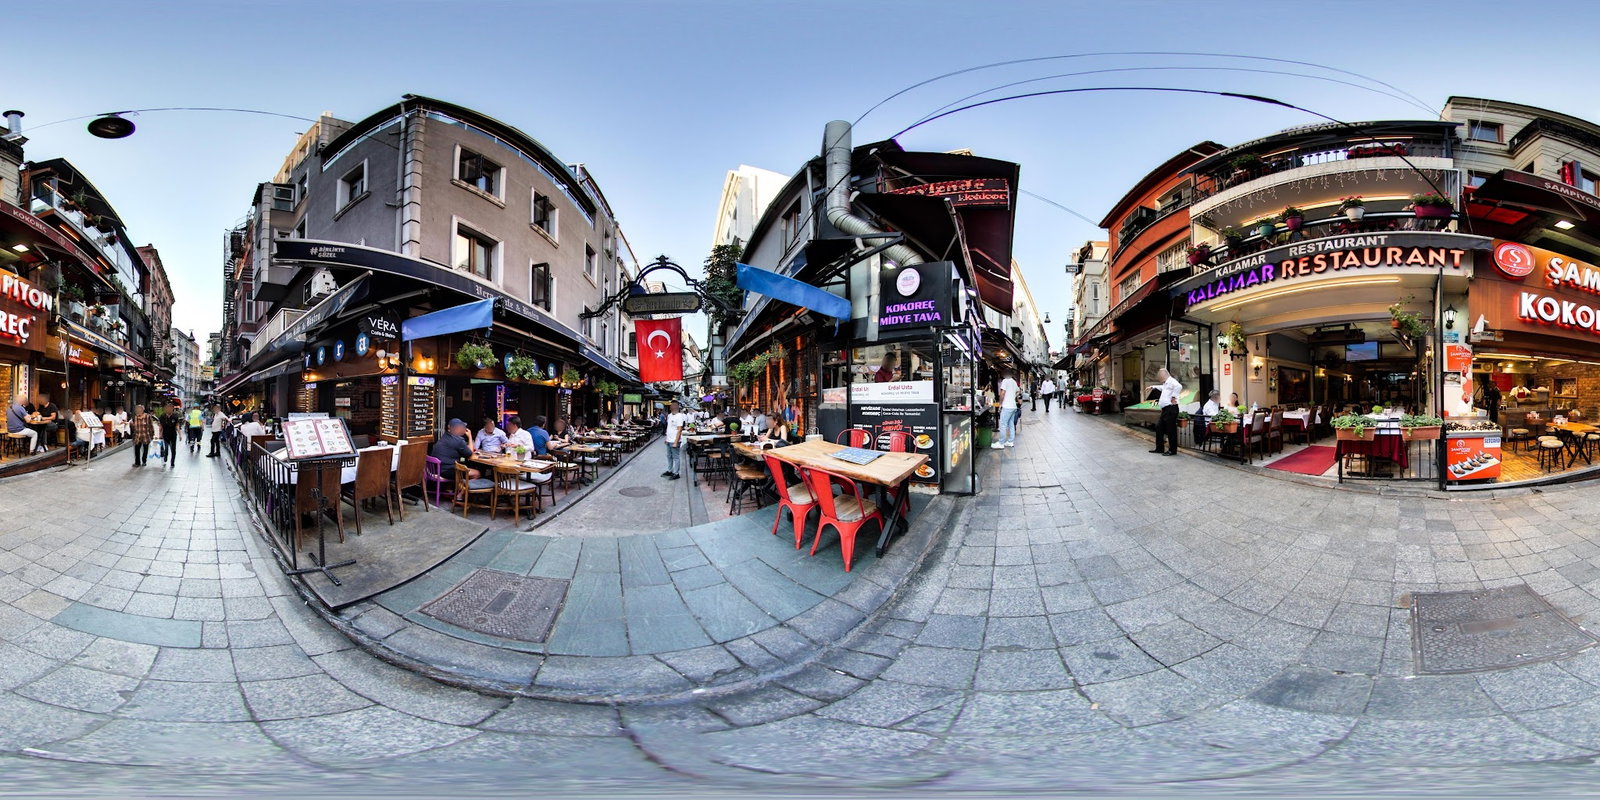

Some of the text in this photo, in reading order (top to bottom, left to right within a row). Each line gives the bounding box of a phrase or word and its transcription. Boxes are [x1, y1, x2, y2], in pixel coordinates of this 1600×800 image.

[1215, 235, 1388, 278] KALAMAR RESTAURANT
[1187, 247, 1464, 305] KALAMAR RESTAURANT
[880, 312, 941, 326] MİDYE TAVA
[885, 300, 936, 313] KOKOREÇ
